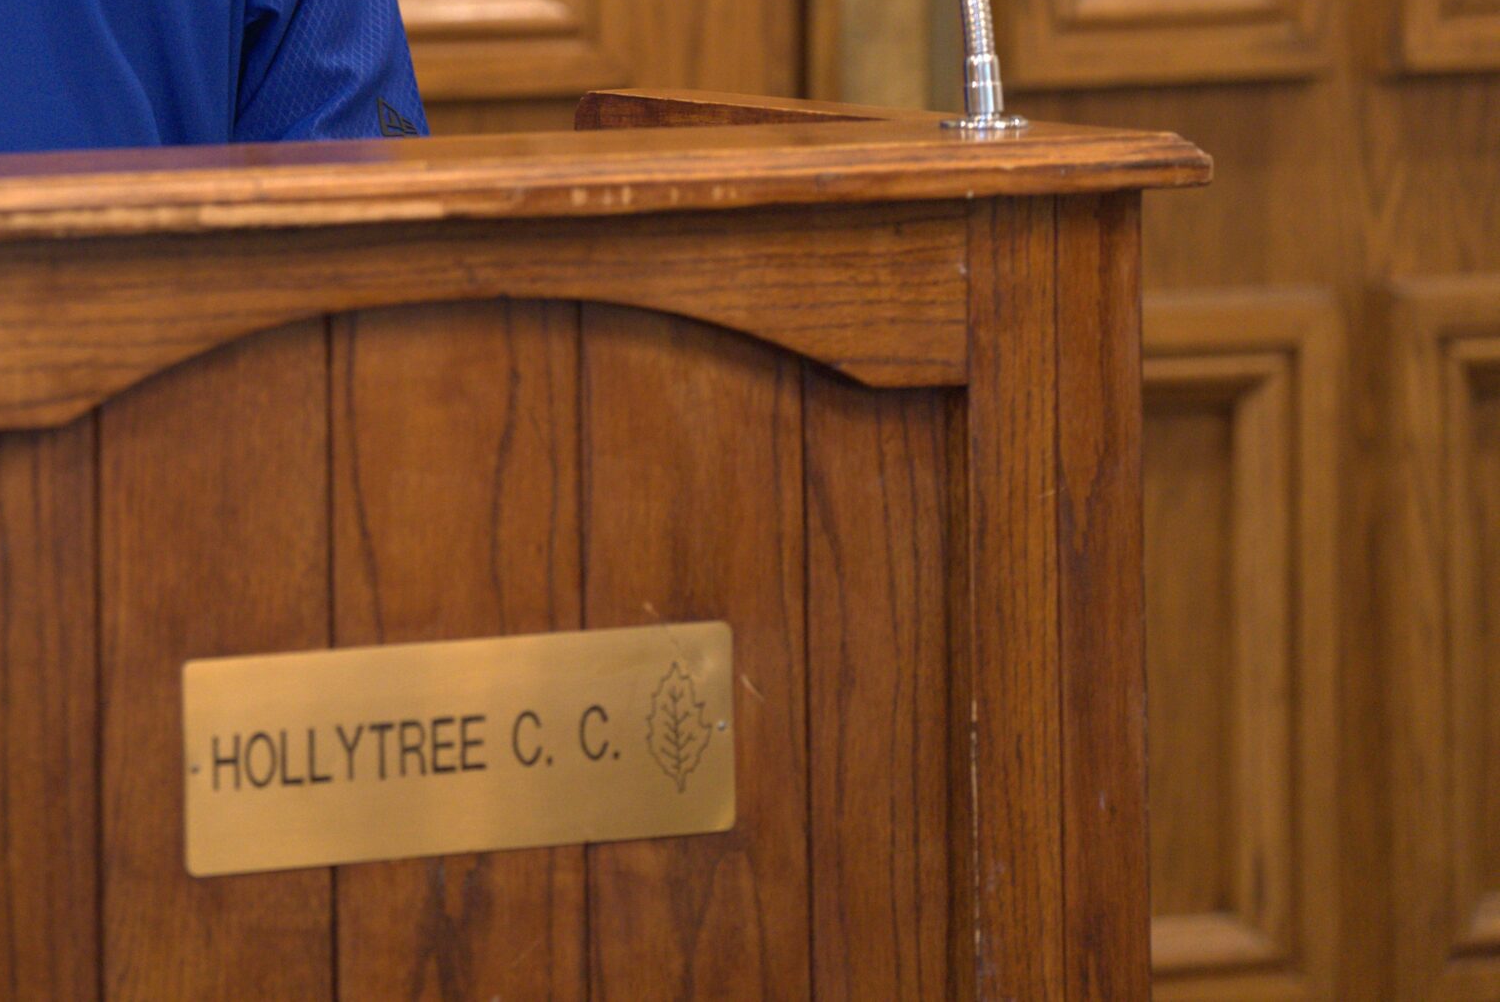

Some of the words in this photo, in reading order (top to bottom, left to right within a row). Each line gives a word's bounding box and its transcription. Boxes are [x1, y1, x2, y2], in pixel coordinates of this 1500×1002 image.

[210, 714, 487, 791] HOLLYTREE
[511, 710, 553, 767] C.
[579, 704, 621, 761] C.
